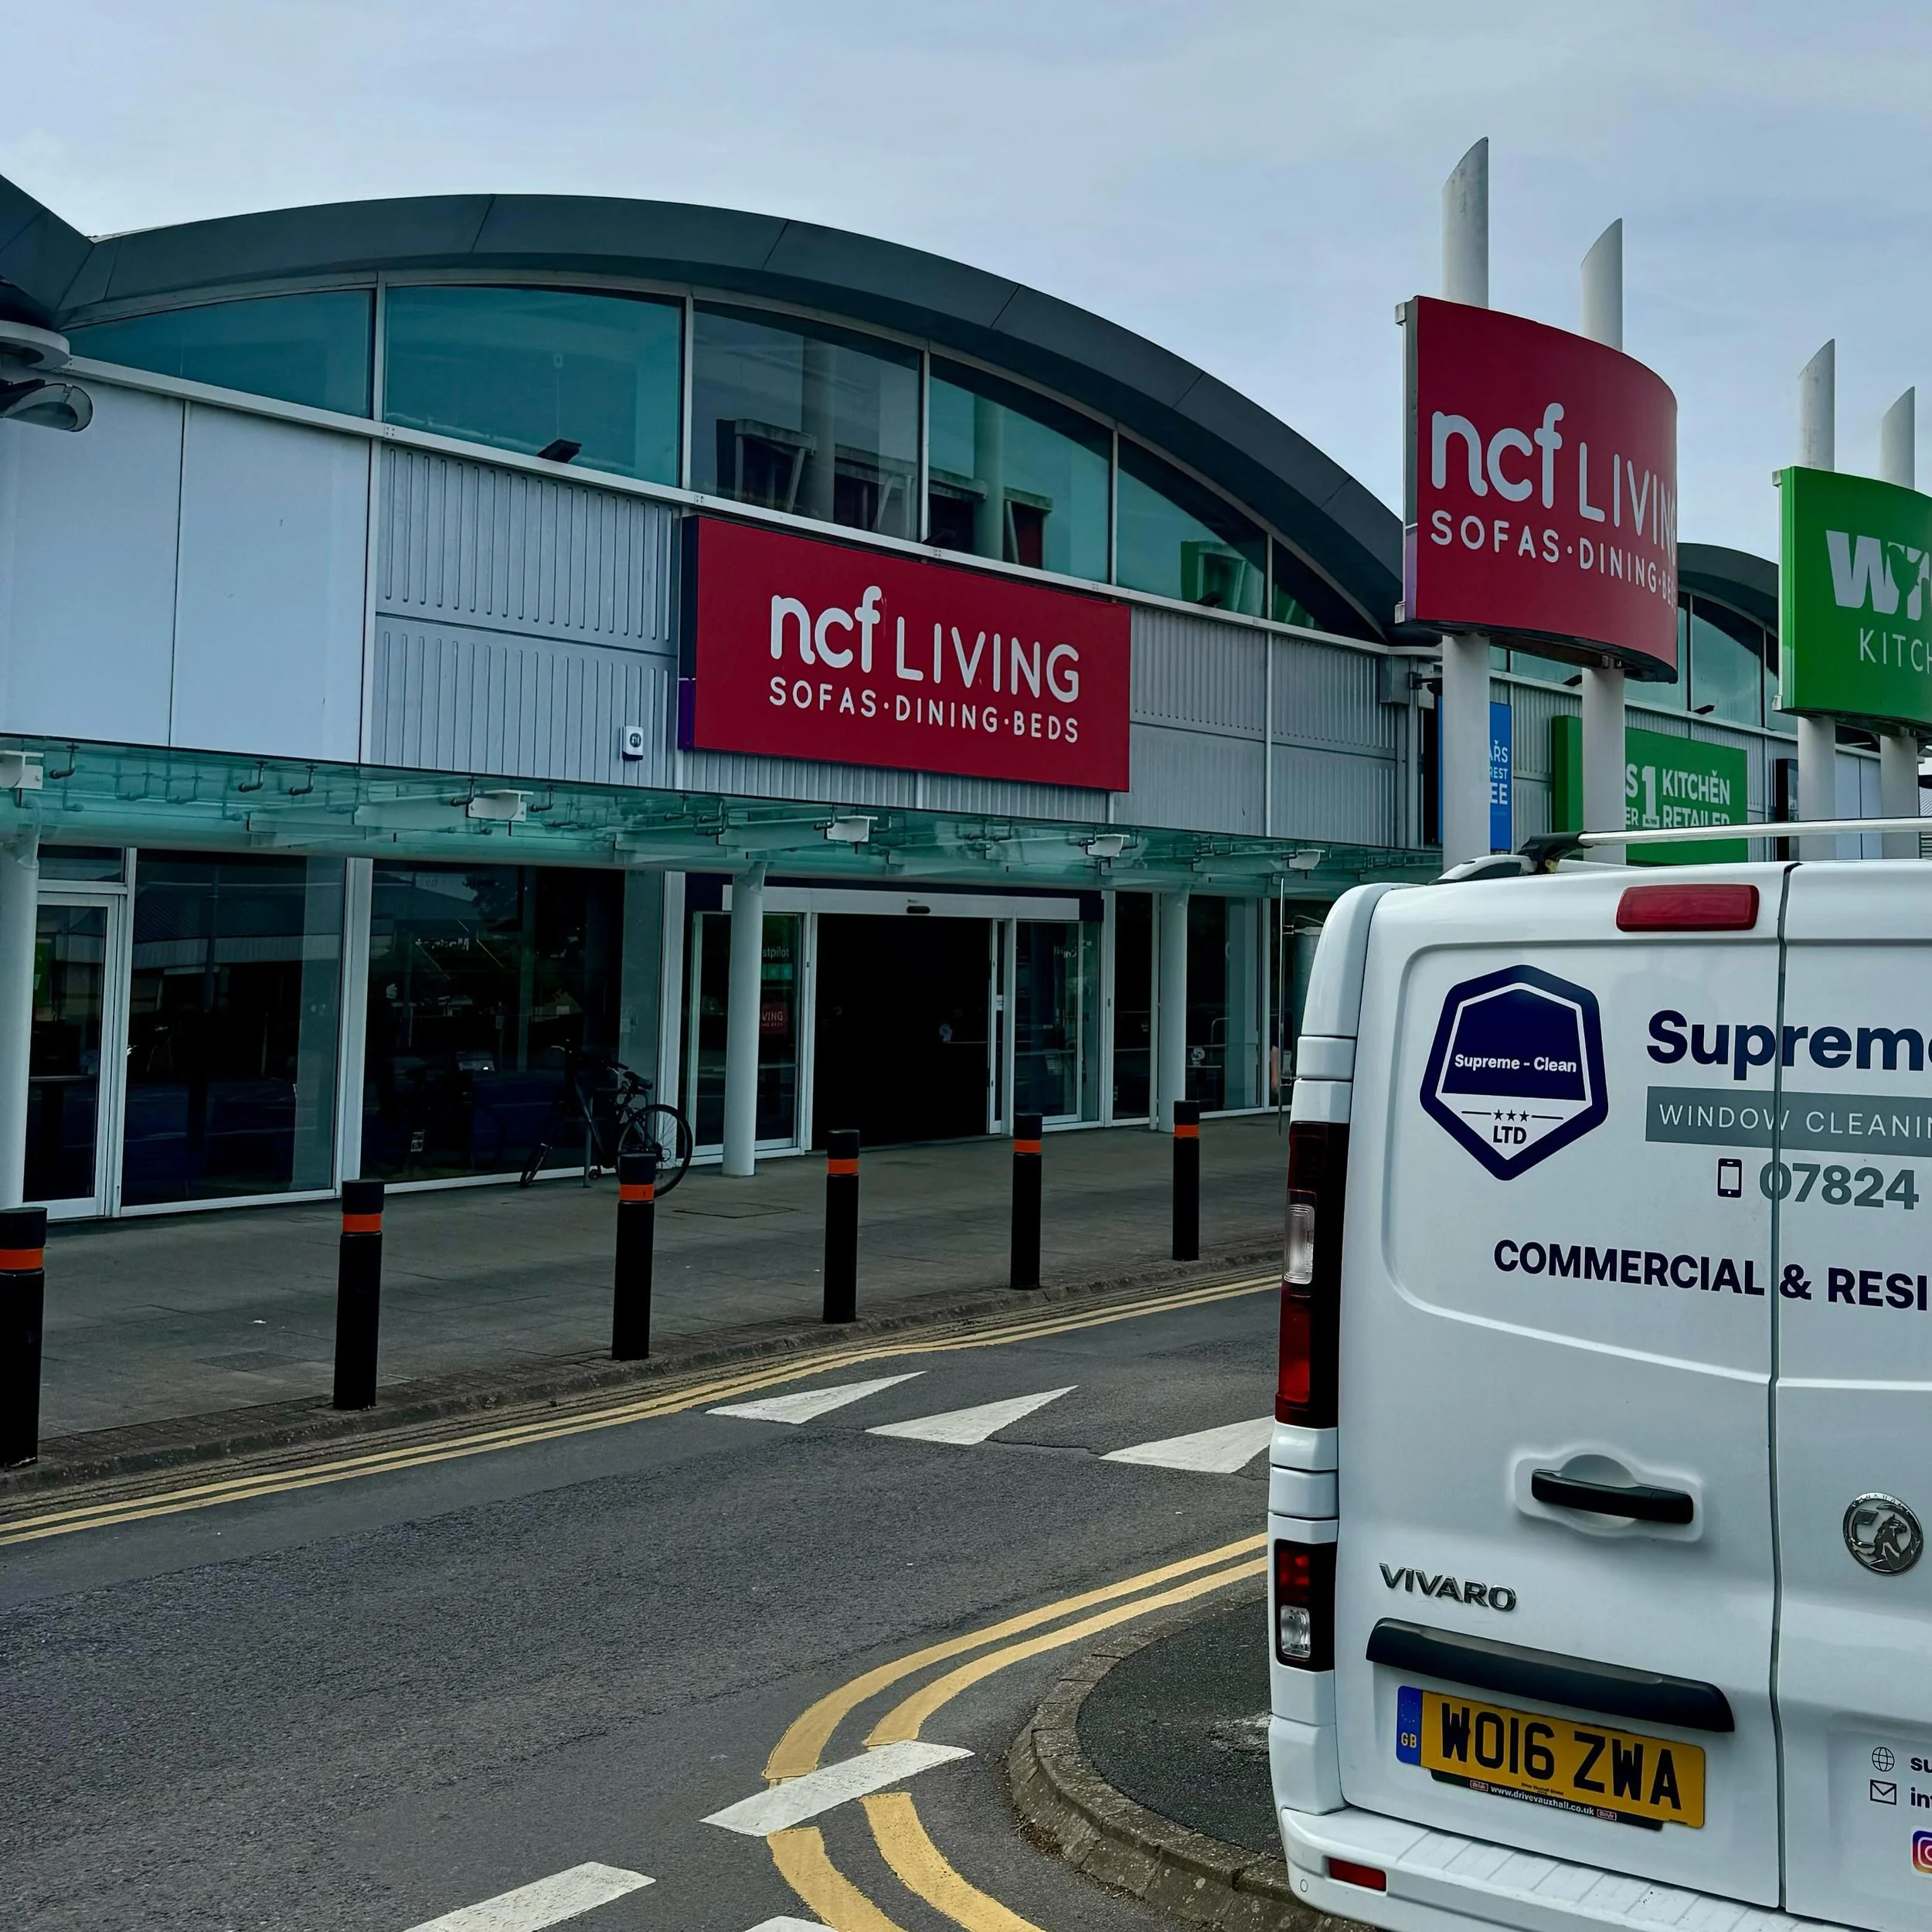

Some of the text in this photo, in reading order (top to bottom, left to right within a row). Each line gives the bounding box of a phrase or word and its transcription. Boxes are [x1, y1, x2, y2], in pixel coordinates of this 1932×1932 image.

[1431, 403, 1565, 509] ncf
[1430, 510, 1560, 563] SOFAS
[771, 585, 1080, 703] ncf LIVING
[770, 676, 1079, 743] SOFAS DINING BEDS
[1454, 1053, 1520, 1072] Supreme
[1533, 1056, 1577, 1073] Clean
[1647, 1009, 1932, 1080] Suprem
[1493, 1125, 1528, 1145] LTD
[1659, 1103, 1790, 1131] WINDOW
[1759, 1161, 1920, 1210] 07824
[1494, 1239, 1765, 1296] COMMERCIAL
[1779, 1263, 1812, 1301] &
[1379, 1563, 1517, 1612] VIVARO
[1400, 1733, 1417, 1749] GB
[1441, 1702, 1682, 1811] WO16 ZWA
[1490, 1784, 1595, 1817] www.drivevauxhall.co.uk
[1910, 1787, 1932, 1809] in
